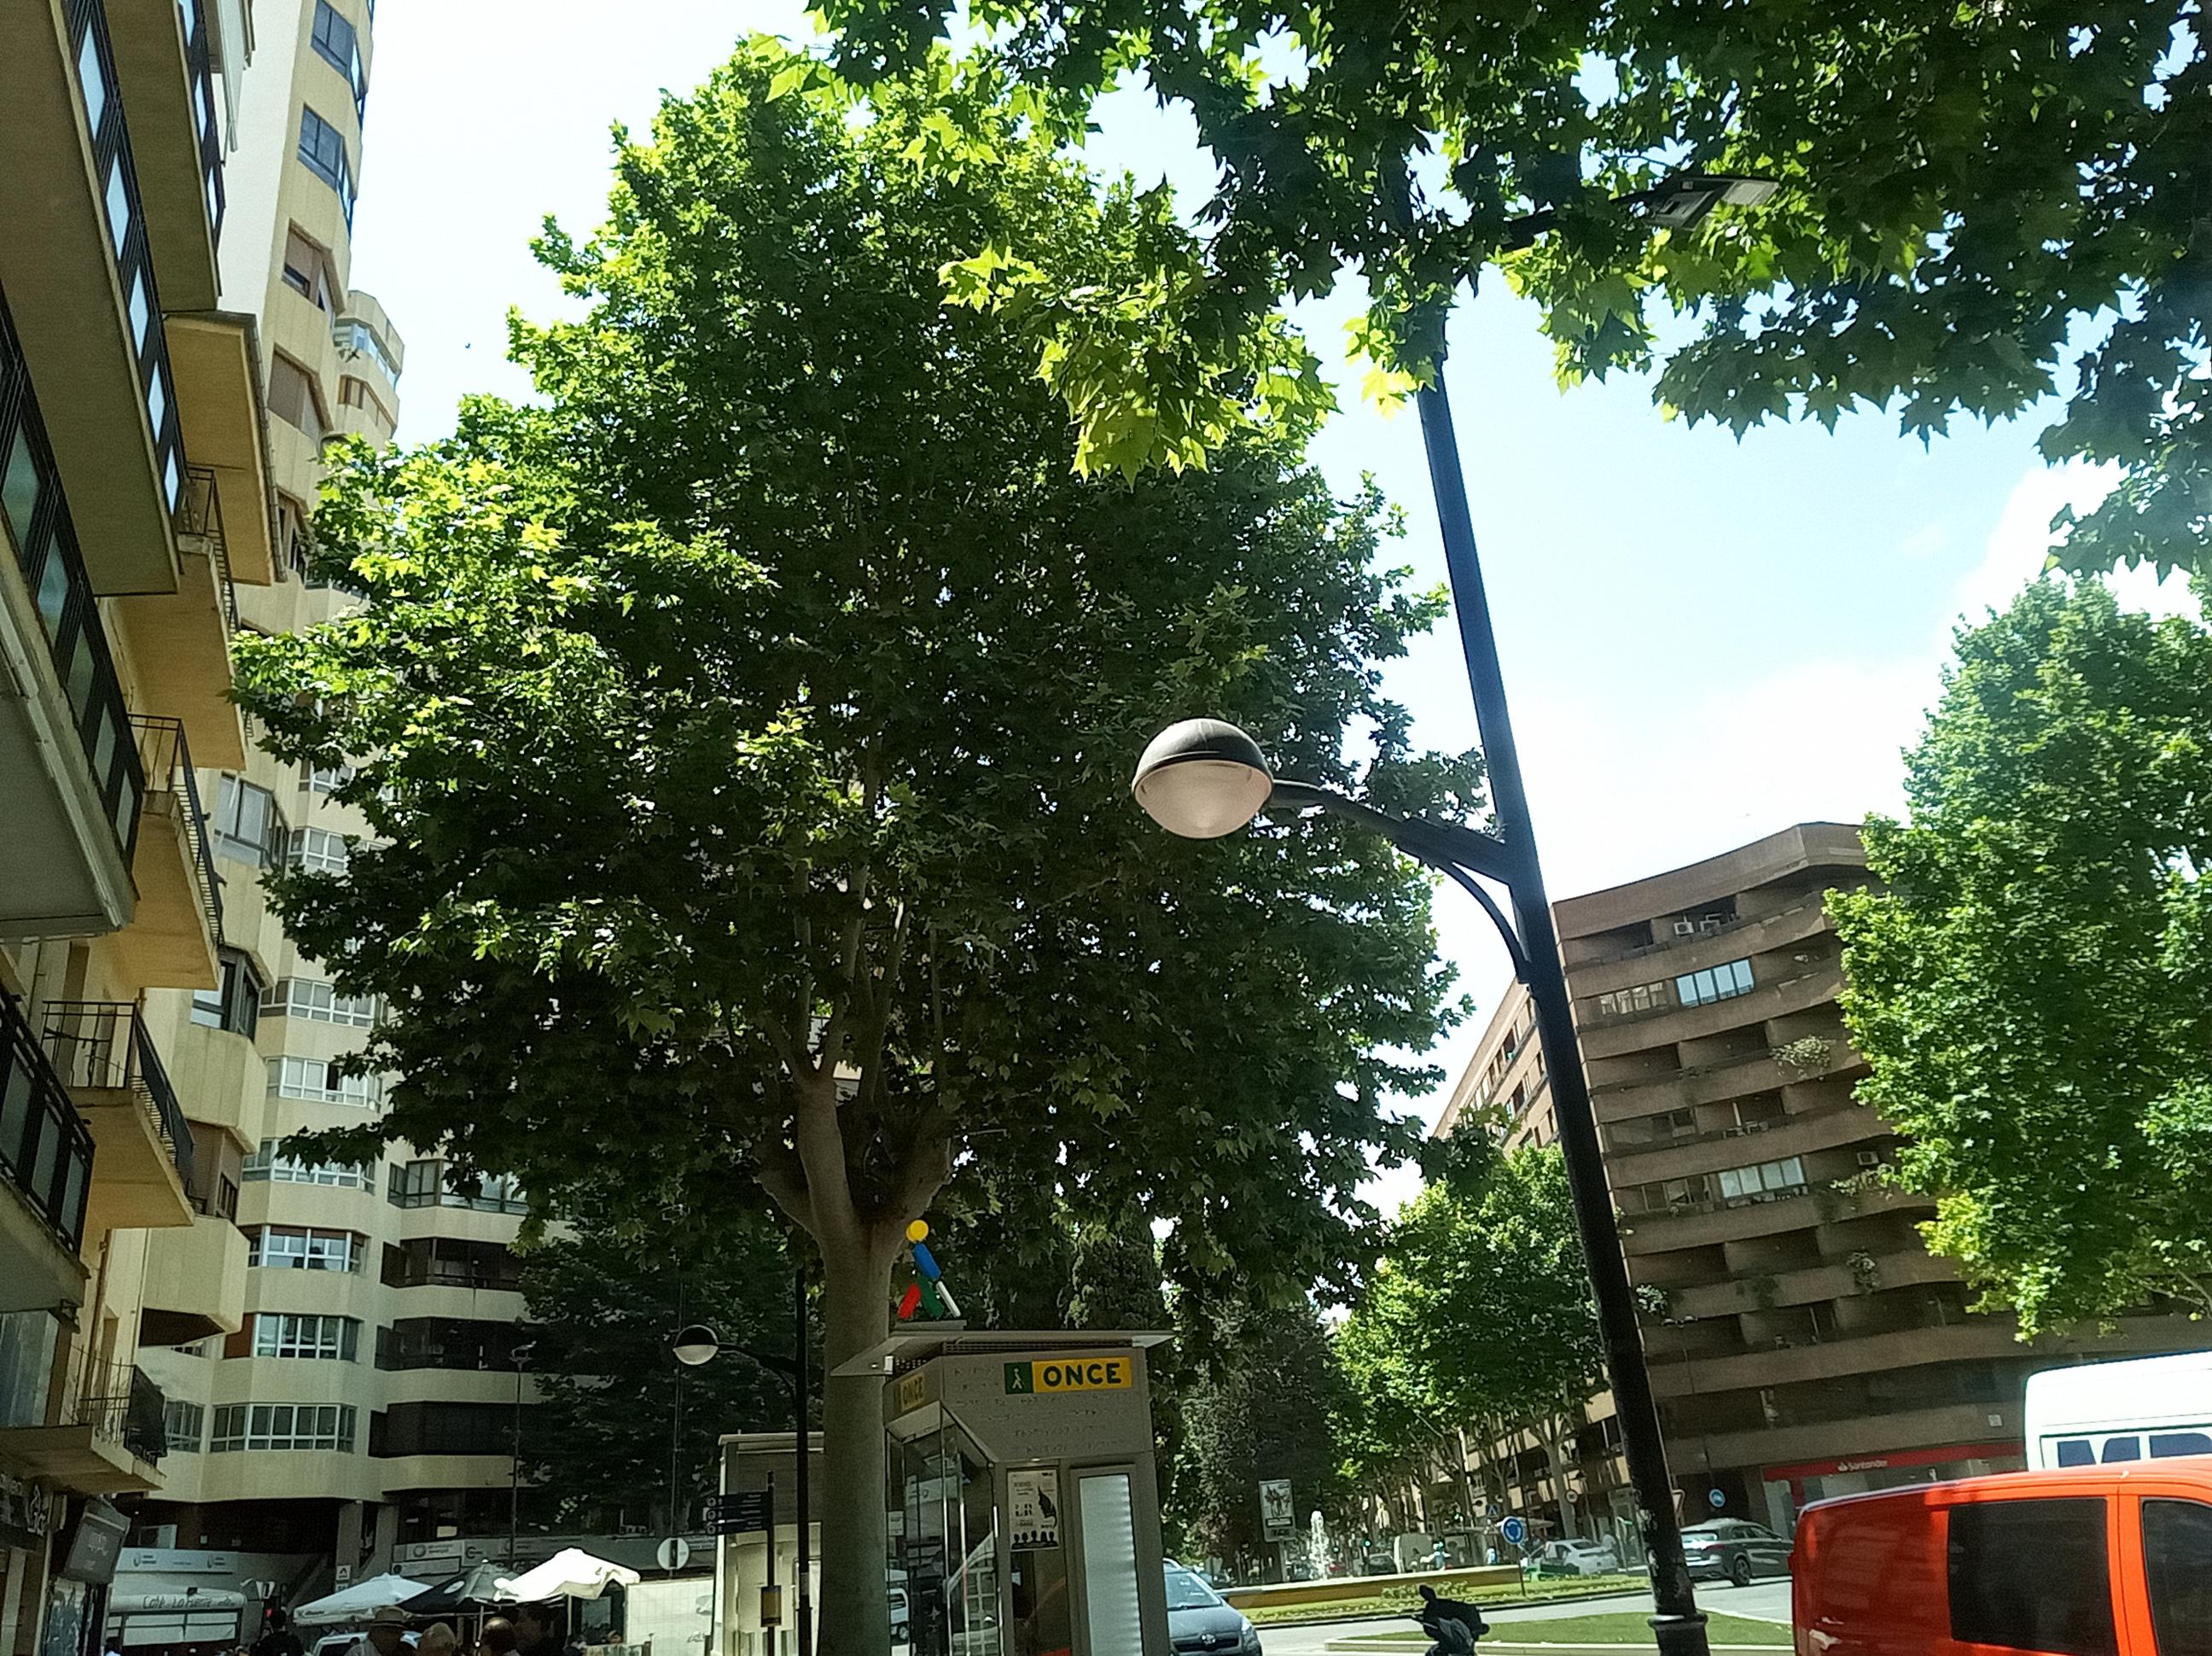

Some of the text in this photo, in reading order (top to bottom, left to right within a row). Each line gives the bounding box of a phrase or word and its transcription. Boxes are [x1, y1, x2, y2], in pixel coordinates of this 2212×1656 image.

[1043, 1362, 1121, 1387] ONCE
[903, 1376, 923, 1405] ONCE
[1848, 1460, 1888, 1471] Santander
